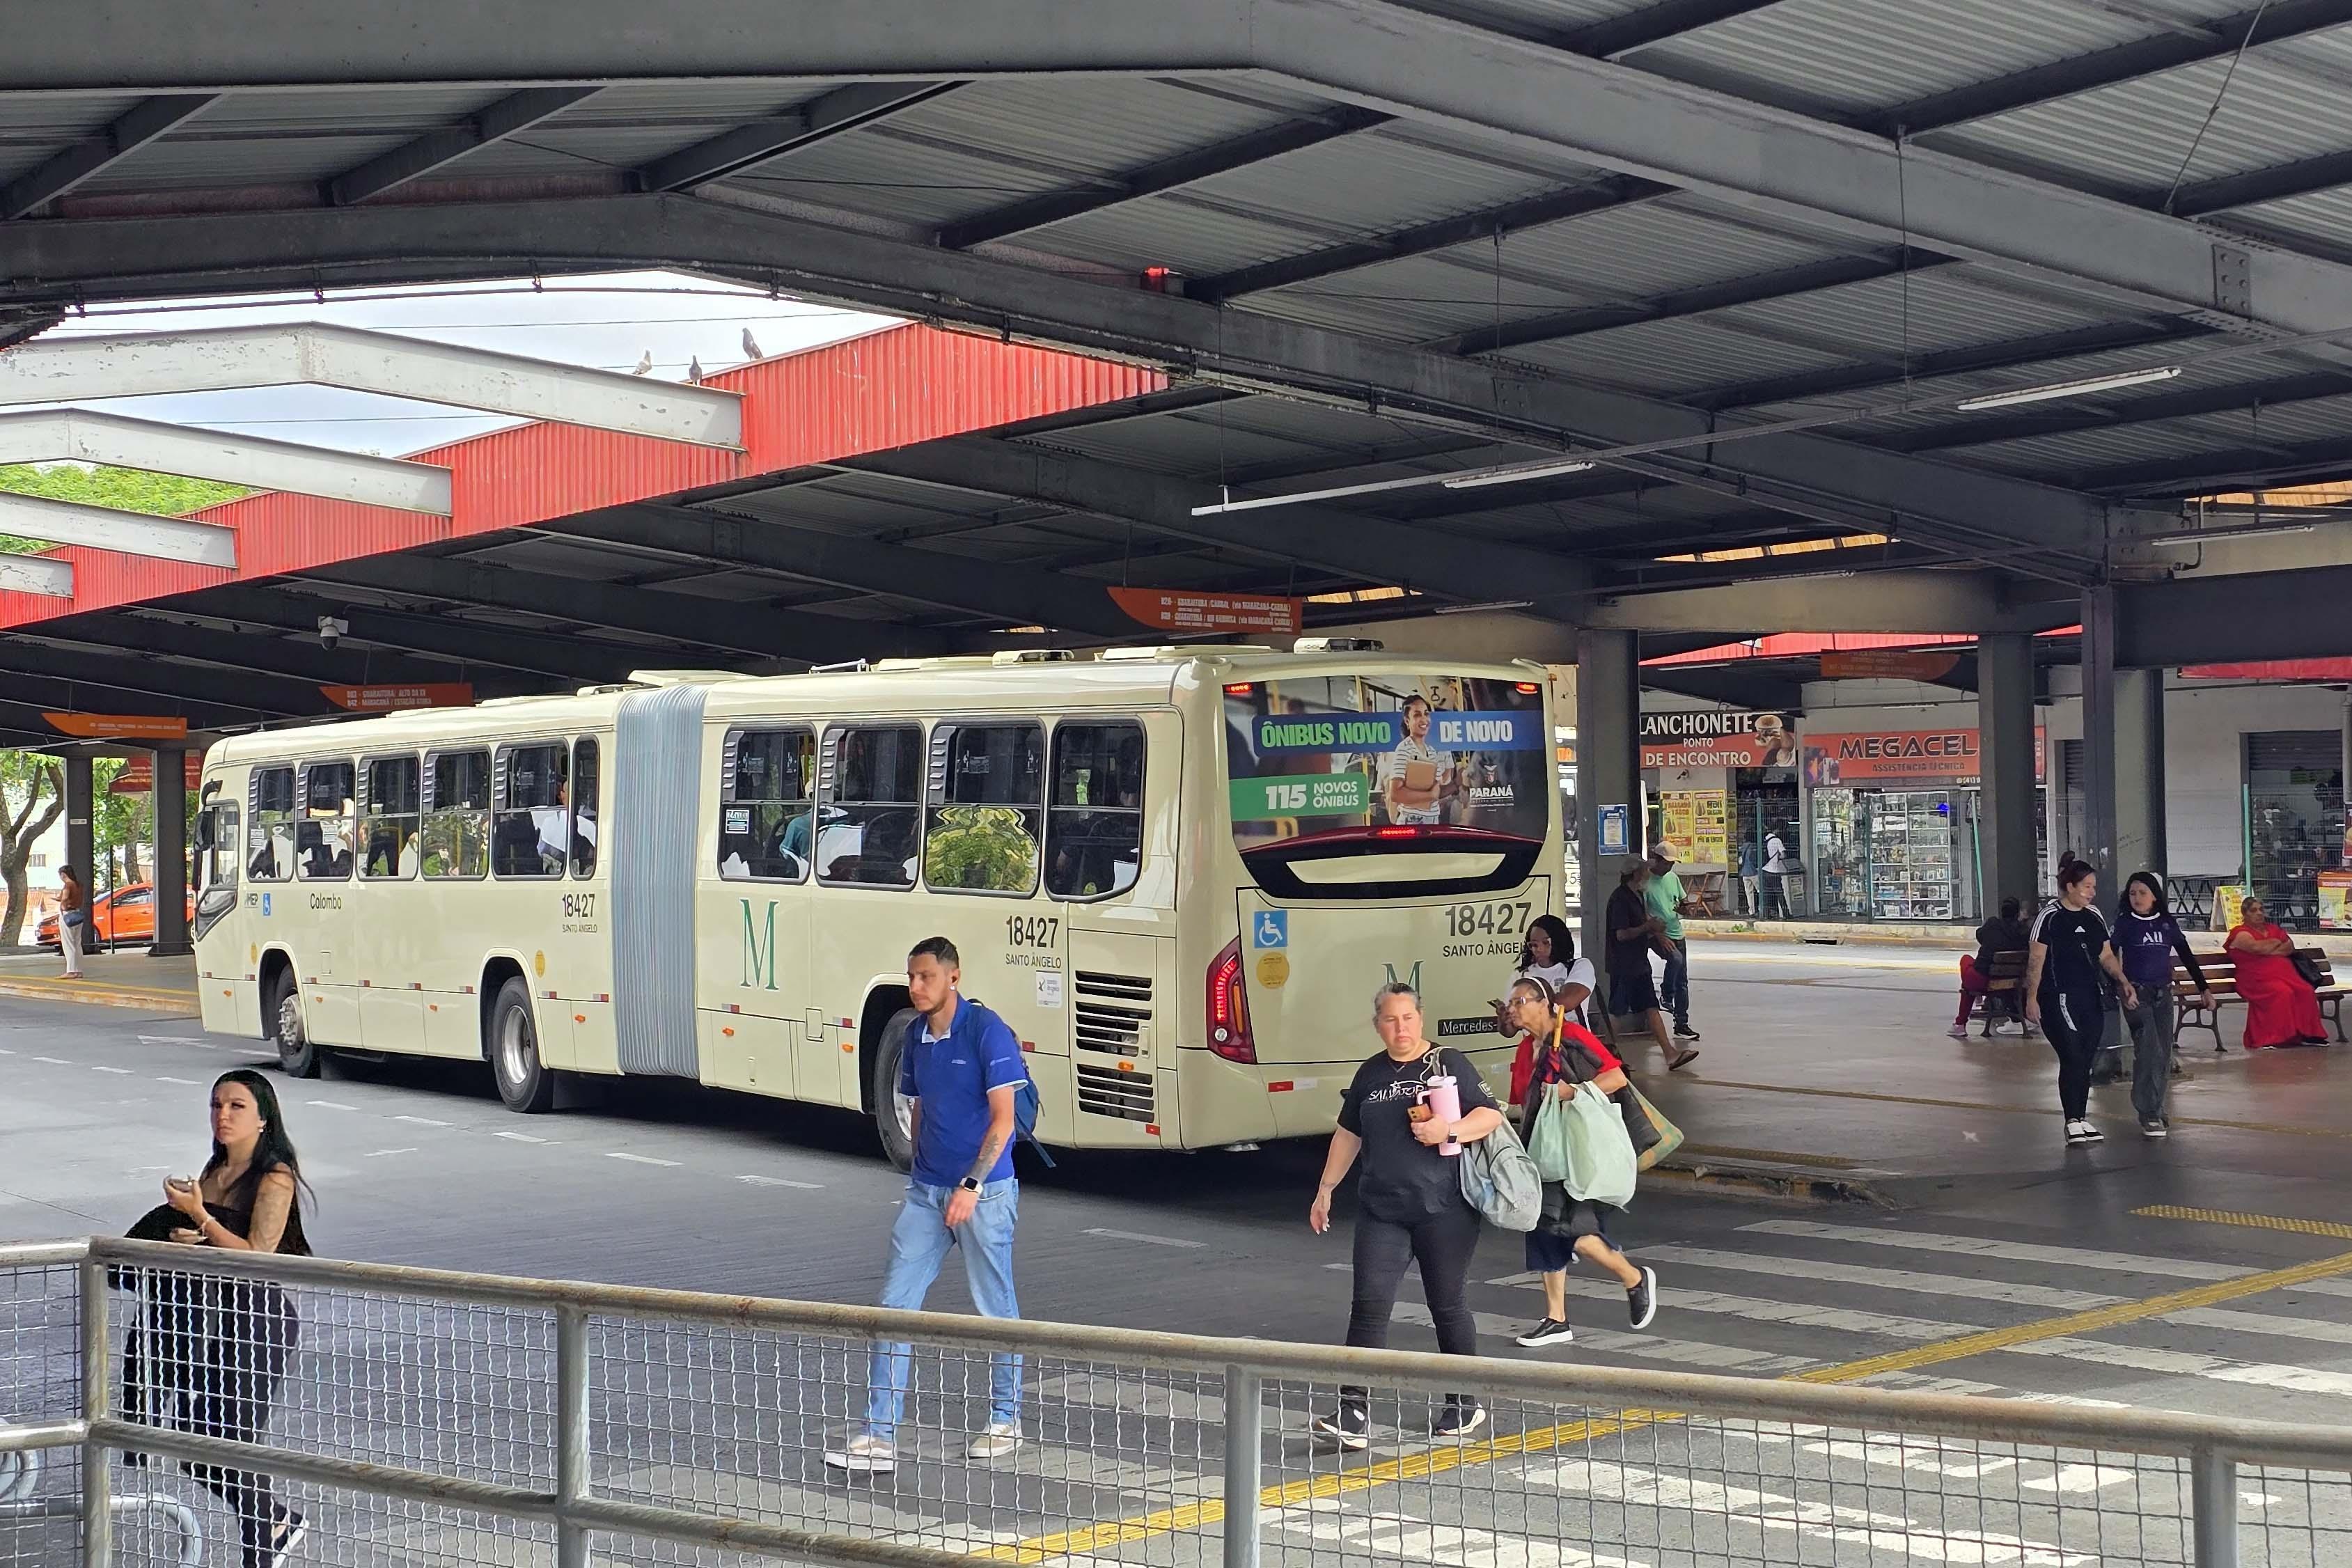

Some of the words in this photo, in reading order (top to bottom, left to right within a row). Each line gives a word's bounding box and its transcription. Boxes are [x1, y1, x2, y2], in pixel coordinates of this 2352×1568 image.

[1640, 713, 1753, 735] LANCHONETE
[1261, 721, 1335, 748] ÔNIBUS
[1339, 721, 1390, 744] NOVO
[1439, 721, 1463, 743] DE
[1466, 720, 1513, 742] NOVO
[1683, 737, 1714, 748] PONTO
[1839, 734, 1979, 760] MEGACEL
[1645, 752, 1664, 766] DE
[1668, 751, 1752, 766] ENCONTRO
[1266, 784, 1307, 810] 115
[1313, 781, 1358, 794] NOVOS
[1312, 793, 1359, 808] ÔNIBUS
[1469, 784, 1514, 798] PARANÁ
[310, 893, 342, 909] Colombo
[562, 893, 595, 918] 18427
[1445, 902, 1532, 936] 18427
[1006, 916, 1059, 948] 18427
[739, 899, 779, 990] M
[1443, 943, 1484, 957] SANTO
[1487, 940, 1525, 956] ÂNGEL
[1005, 953, 1029, 966] SANTO
[1443, 1019, 1498, 1035] Mercedes-
